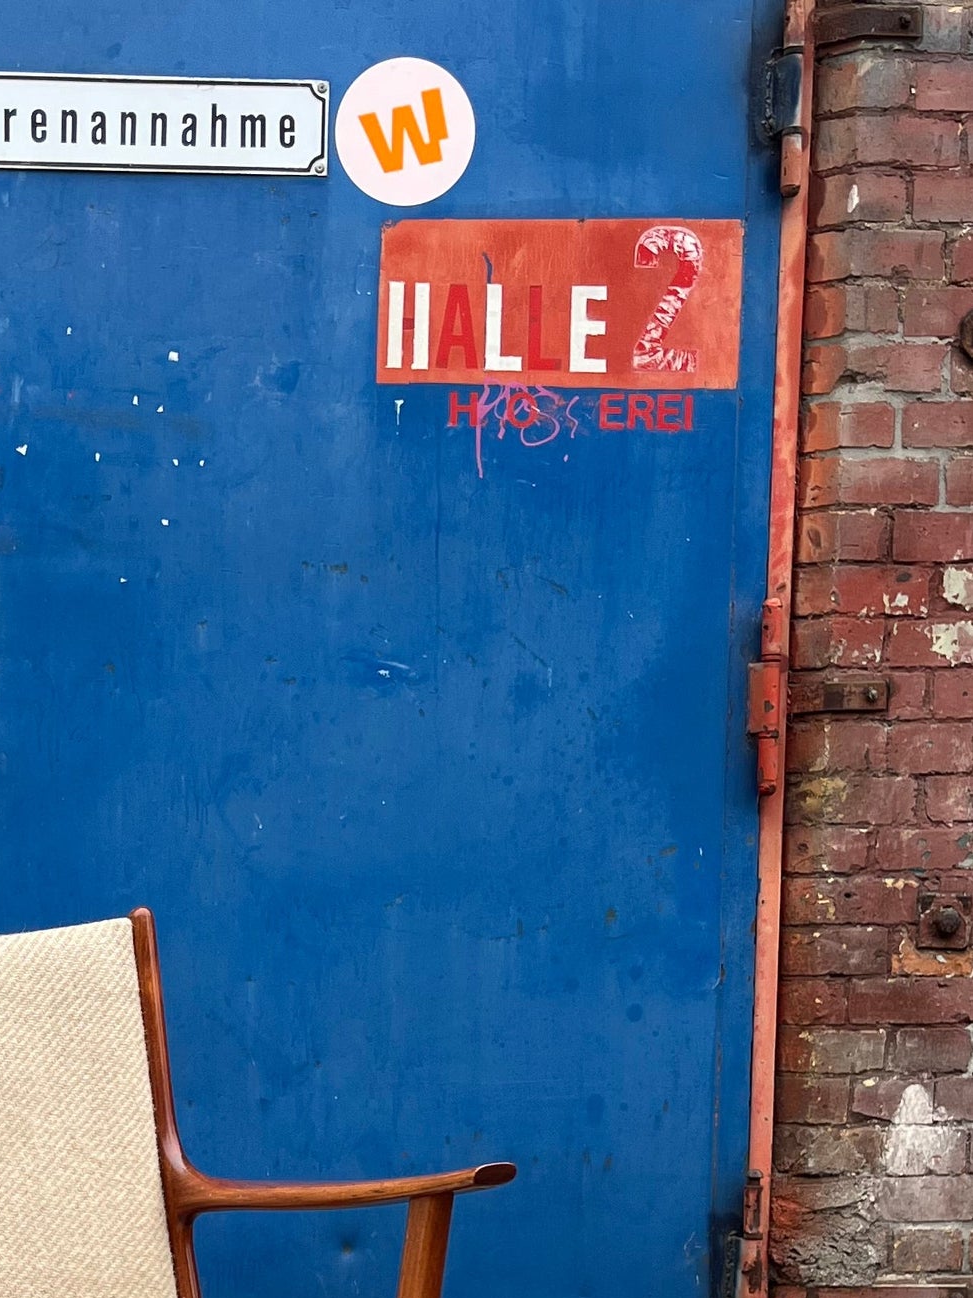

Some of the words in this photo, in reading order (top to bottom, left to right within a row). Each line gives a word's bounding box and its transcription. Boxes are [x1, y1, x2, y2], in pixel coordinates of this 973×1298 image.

[358, 87, 449, 174] W
[385, 281, 608, 373] HALLE
[632, 225, 704, 373] 2
